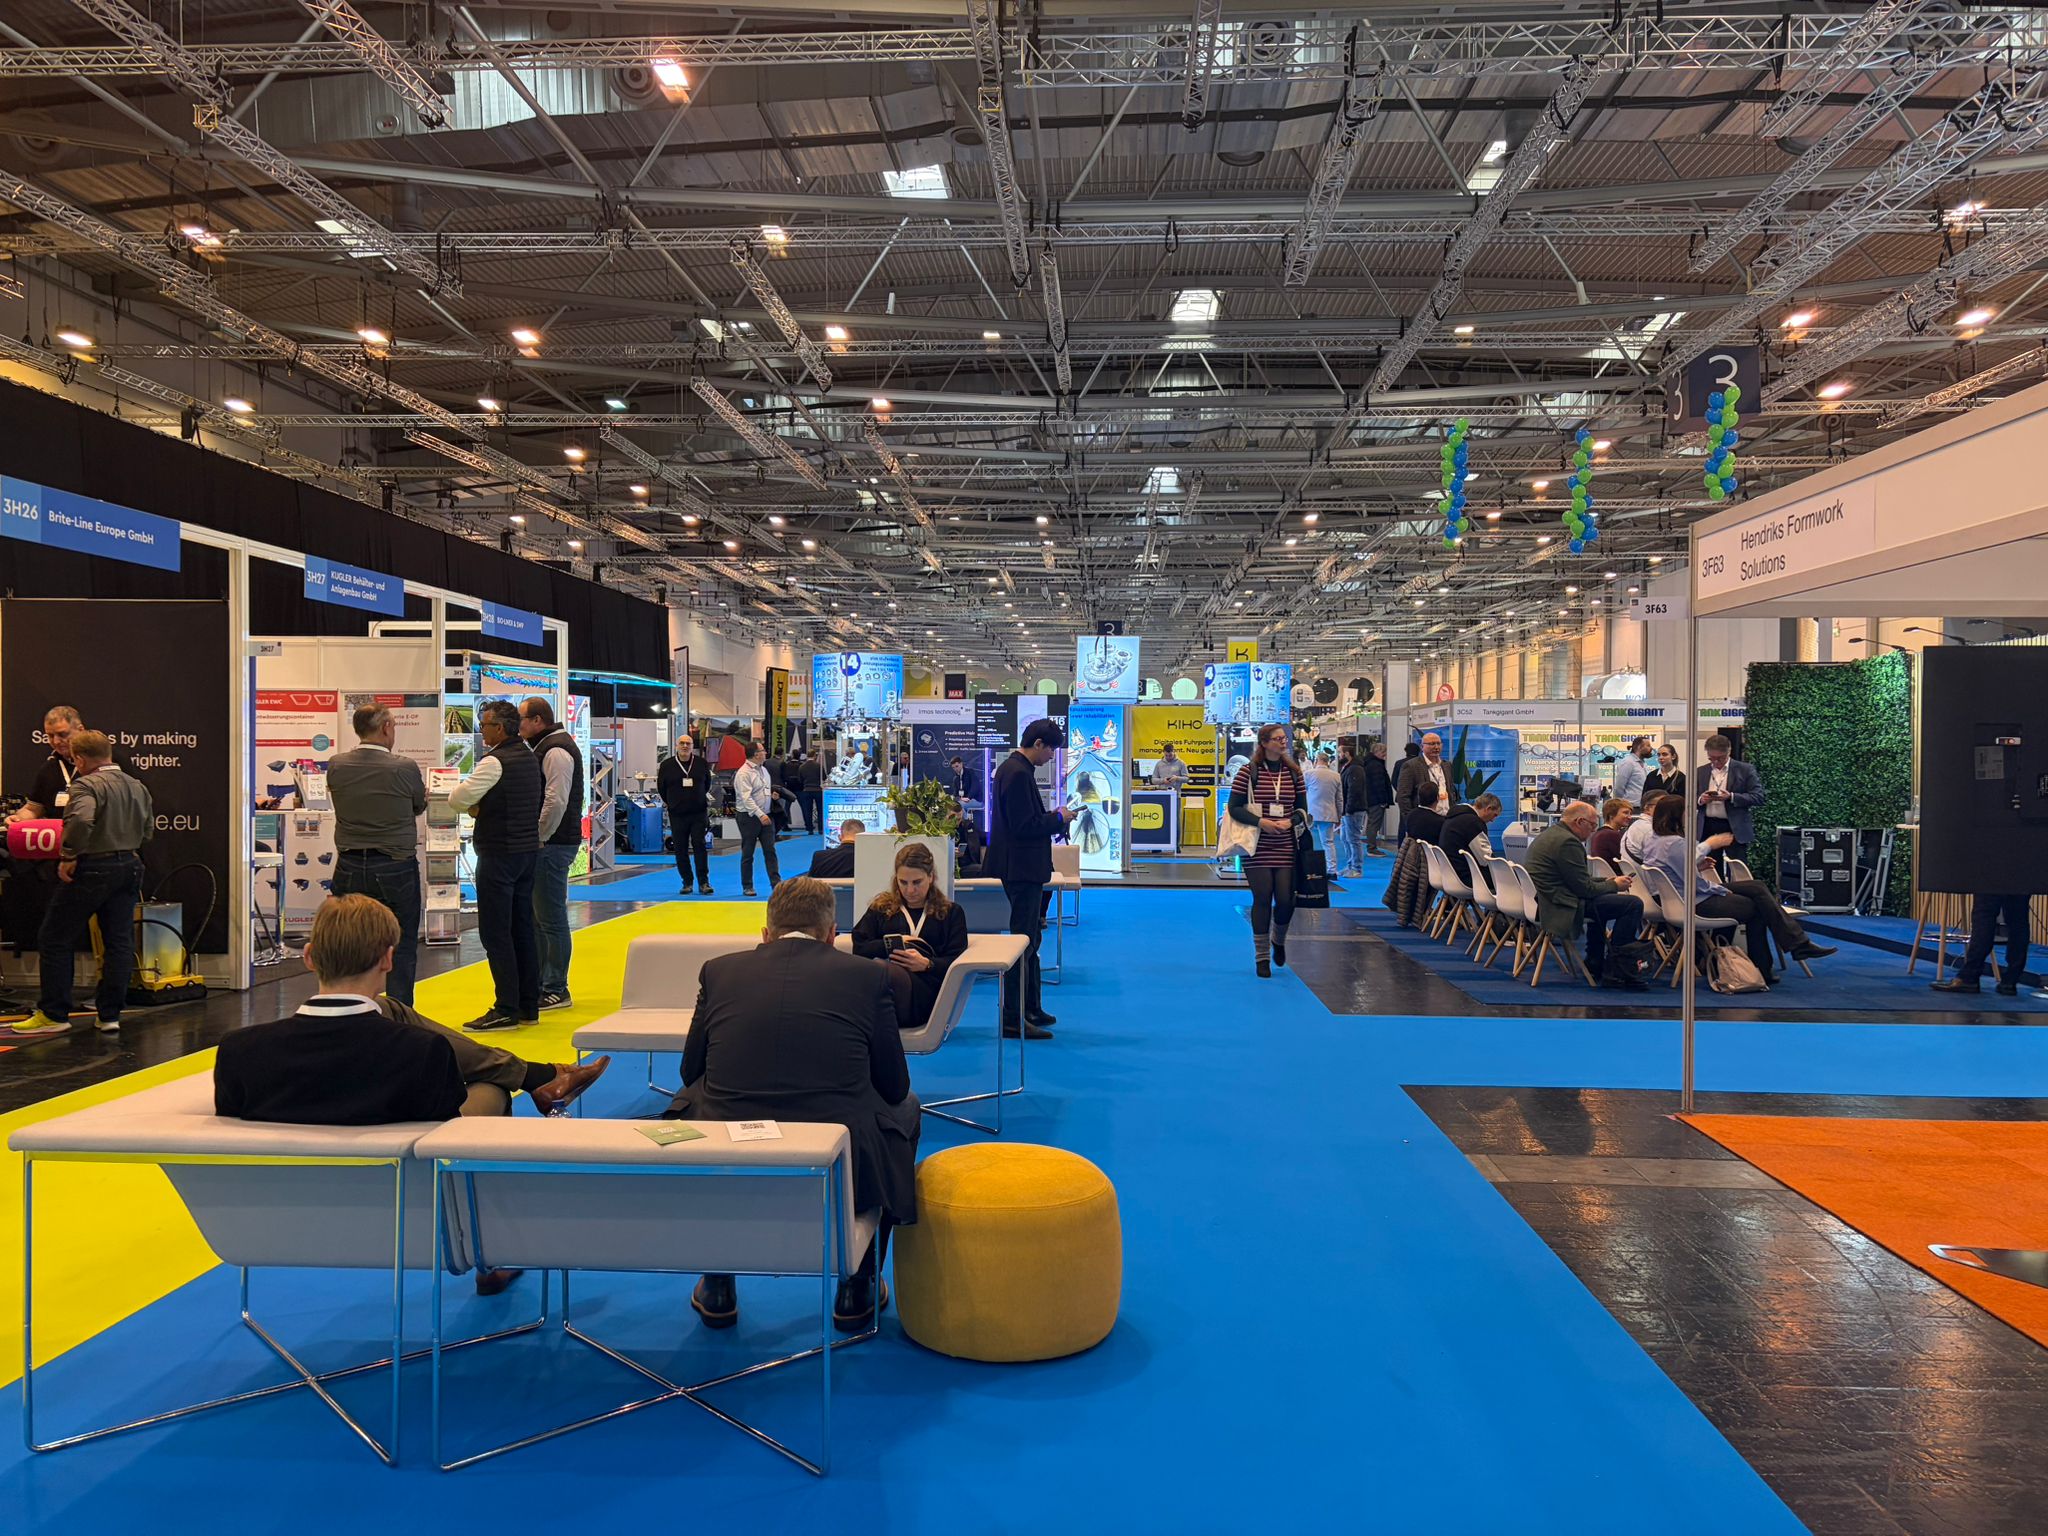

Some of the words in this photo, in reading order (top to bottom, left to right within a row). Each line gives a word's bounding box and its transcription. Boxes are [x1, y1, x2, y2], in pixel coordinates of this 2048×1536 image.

[3, 498, 39, 520] 3H26
[48, 510, 93, 531] Brite-Line
[95, 522, 126, 539] Europe
[128, 529, 154, 545] GmbH
[1741, 523, 1784, 551] Hendriks
[1788, 499, 1844, 535] Formwork
[1702, 555, 1724, 578] 3F63
[1740, 554, 1786, 581] Solutions
[306, 570, 326, 585] 3H27
[330, 570, 352, 583] KUGLER
[375, 582, 386, 591] und
[330, 584, 361, 598] Anlagenbau
[361, 591, 377, 601] GmbH
[1645, 604, 1668, 614] 3F63
[840, 654, 859, 670] 14
[1235, 648, 1249, 661] K
[935, 708, 961, 717] technolog
[1600, 707, 1665, 717] TANKGIGANT
[1698, 708, 1745, 717] ANKGIGA
[1167, 719, 1203, 730] KIHO
[120, 731, 139, 748] by
[143, 731, 198, 749] making
[1154, 739, 1183, 747] Digitales
[1184, 739, 1216, 747] Fuhrpark-
[1521, 733, 1587, 742] TANKGIGANT
[131, 754, 182, 770] righter.
[153, 814, 200, 832] e.eu
[1132, 812, 1160, 821] KIHO
